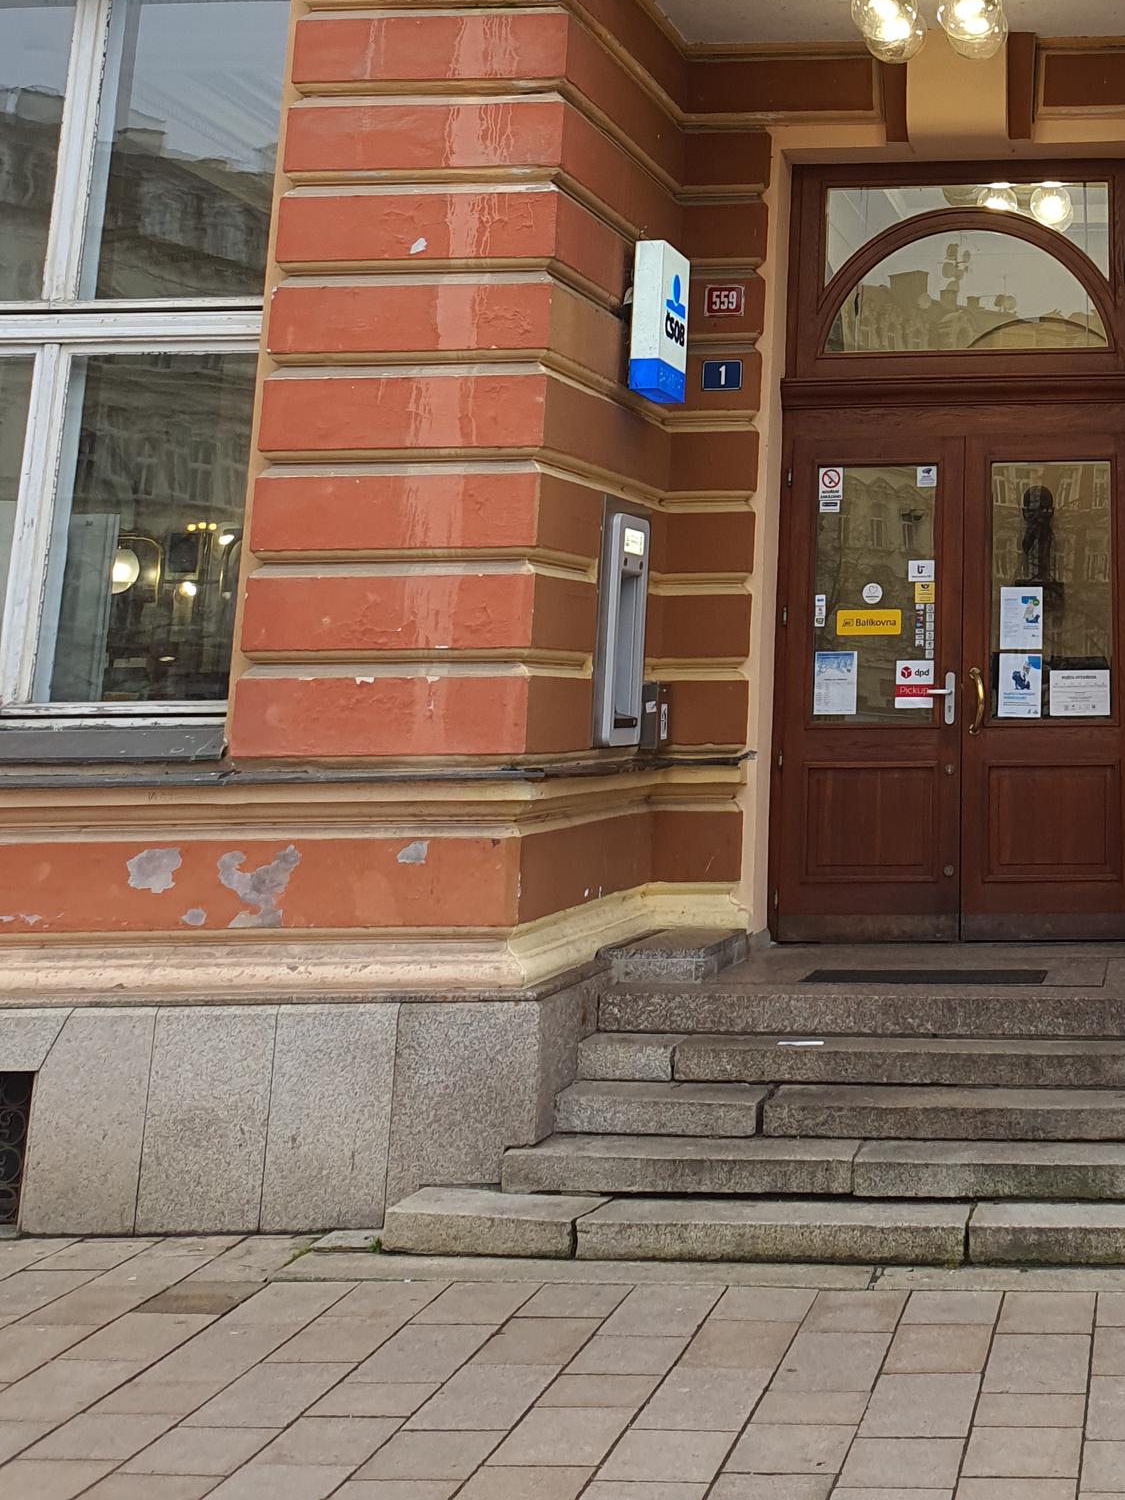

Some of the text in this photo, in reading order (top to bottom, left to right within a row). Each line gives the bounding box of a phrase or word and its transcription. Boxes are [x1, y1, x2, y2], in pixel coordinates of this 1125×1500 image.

[712, 290, 737, 310] 559
[719, 364, 726, 386] 1
[914, 668, 930, 678] dpd
[899, 686, 929, 697] Pickup
